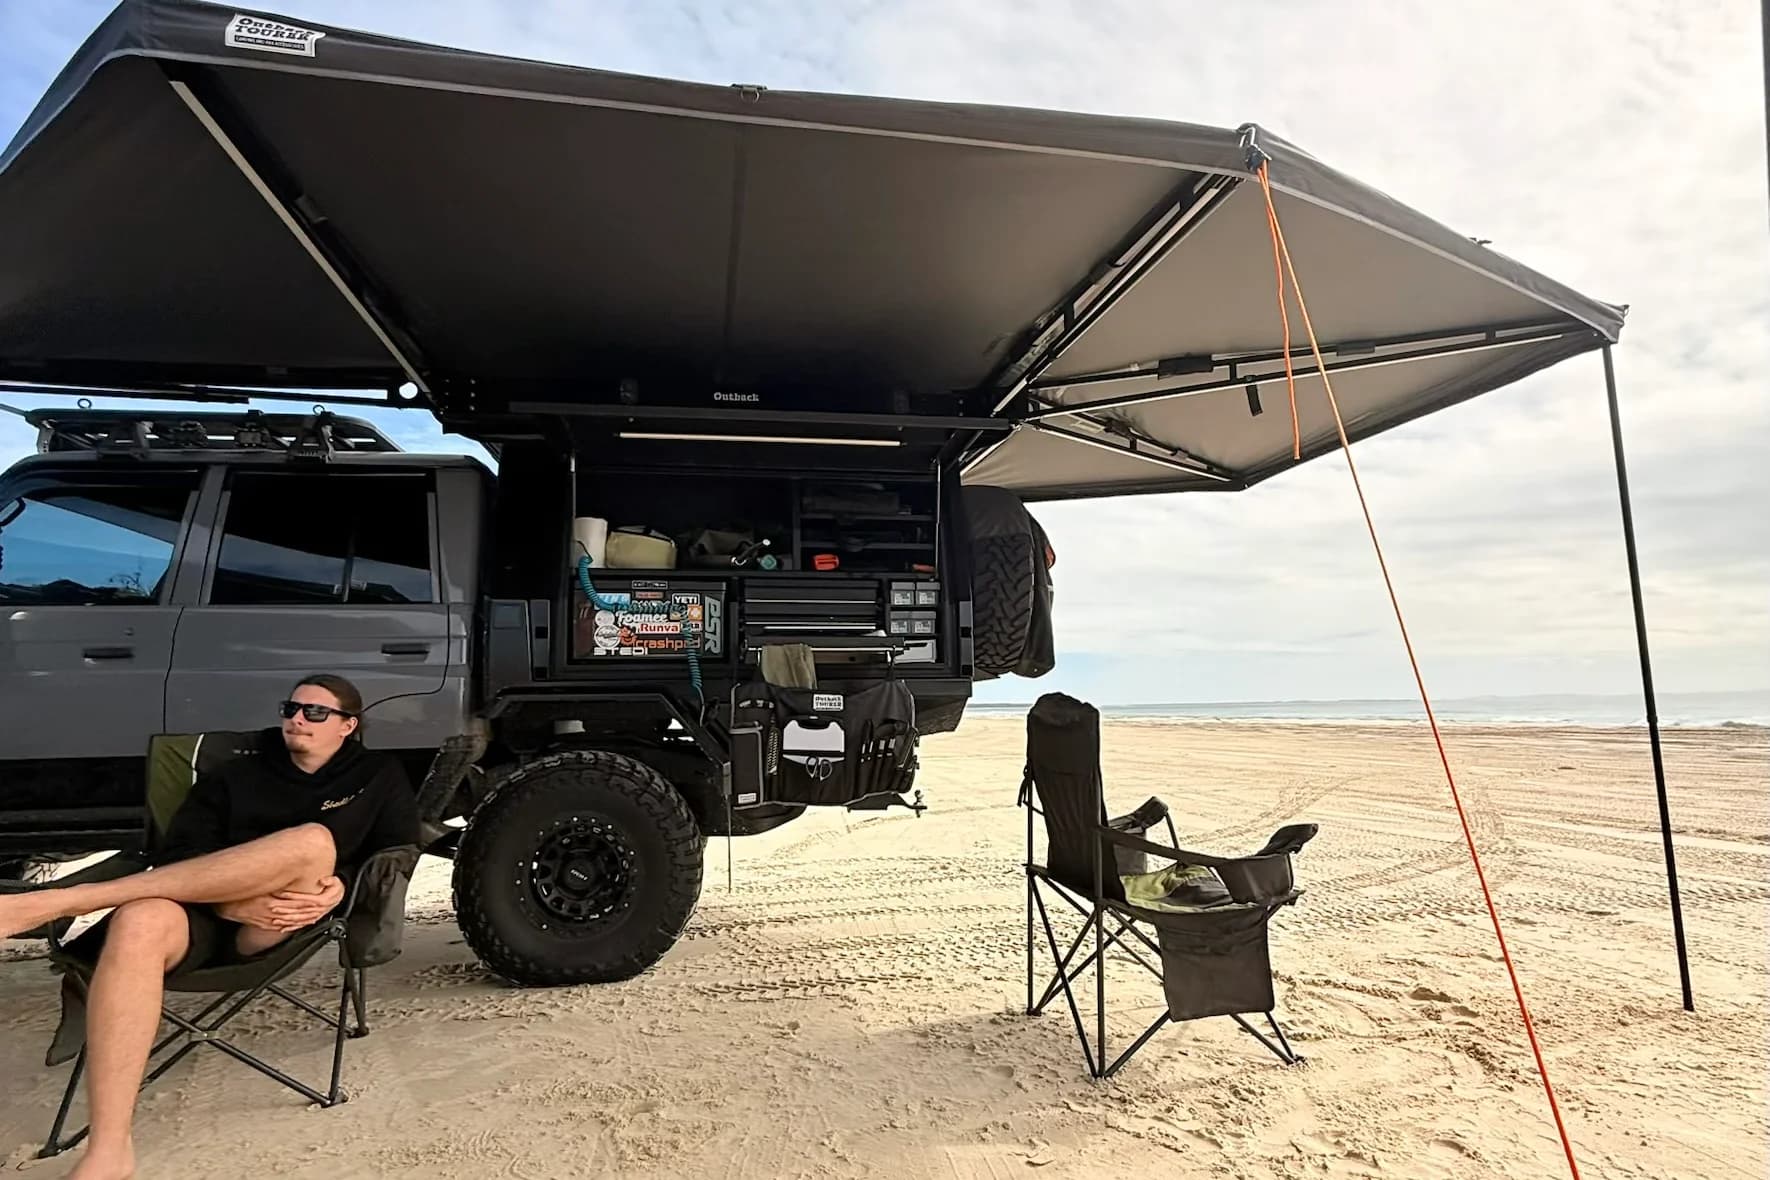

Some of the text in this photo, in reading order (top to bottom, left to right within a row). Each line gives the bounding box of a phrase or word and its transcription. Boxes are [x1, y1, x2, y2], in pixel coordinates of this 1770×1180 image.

[234, 24, 310, 41] TOURER
[713, 391, 760, 402] Outback
[674, 596, 698, 604] YETI
[640, 623, 679, 632] Runva
[593, 647, 648, 656] STEDI
